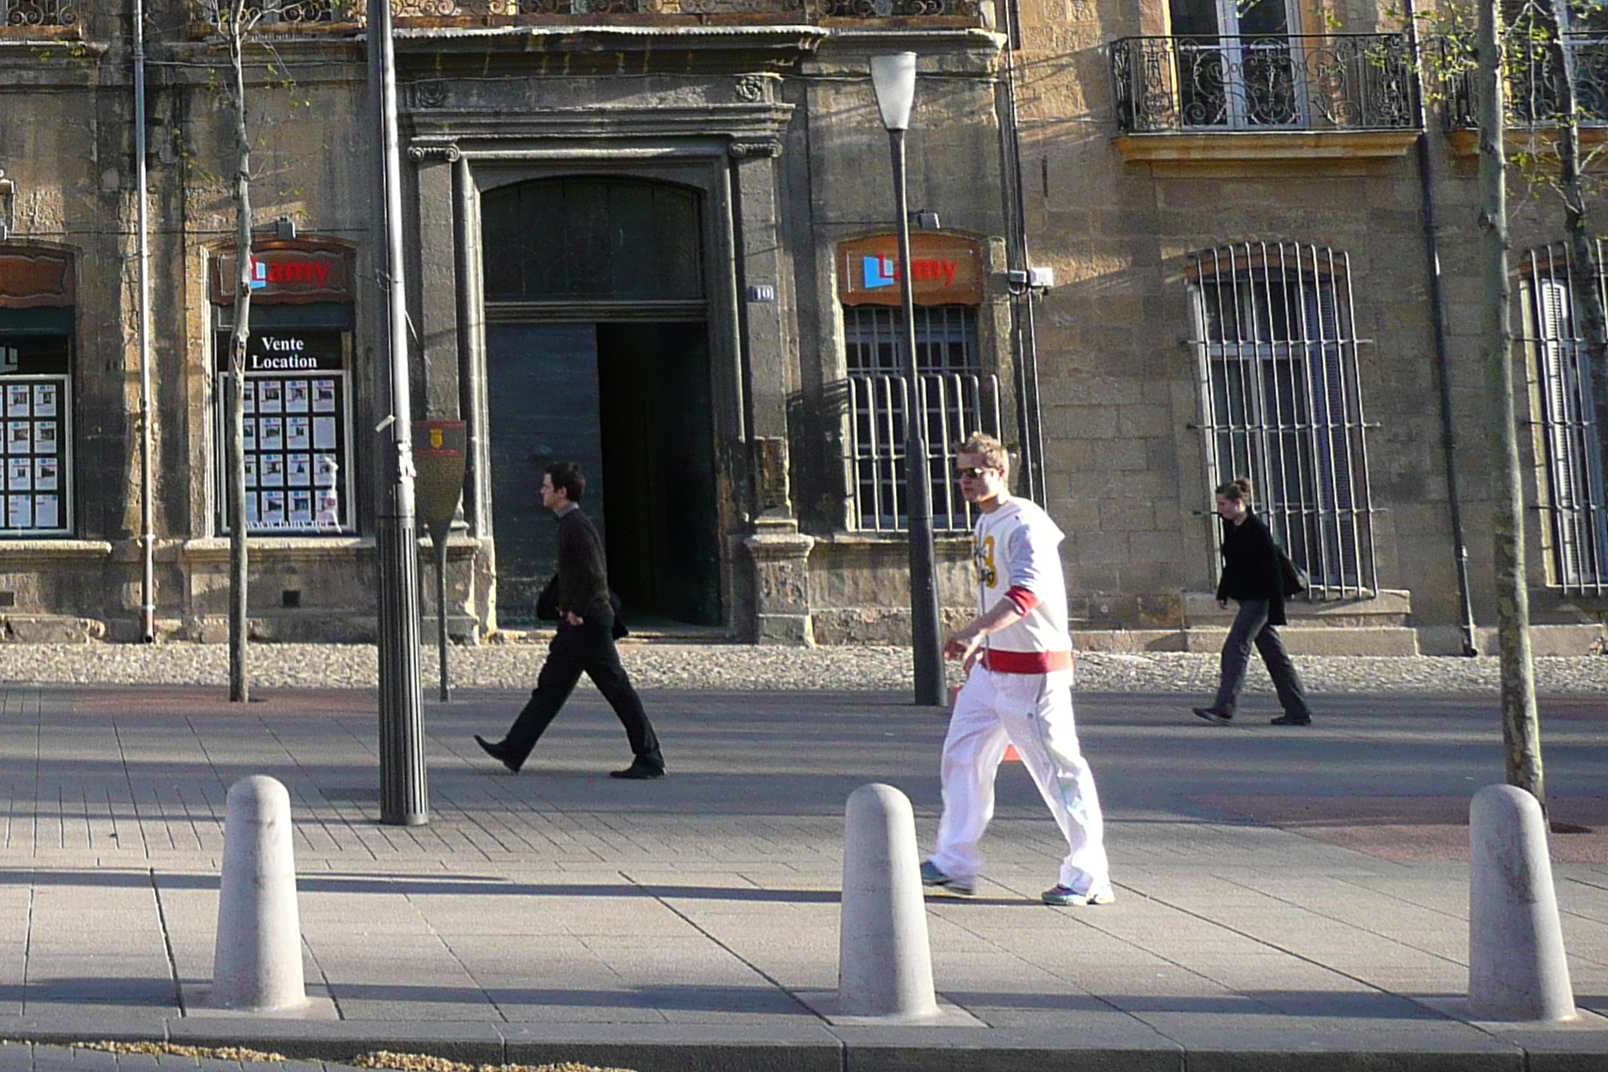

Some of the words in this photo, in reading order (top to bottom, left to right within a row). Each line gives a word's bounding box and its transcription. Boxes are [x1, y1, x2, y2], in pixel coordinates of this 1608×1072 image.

[251, 256, 331, 289] Lamy
[757, 287, 772, 299] 10
[262, 337, 304, 351] Vente
[252, 354, 318, 369] Location
